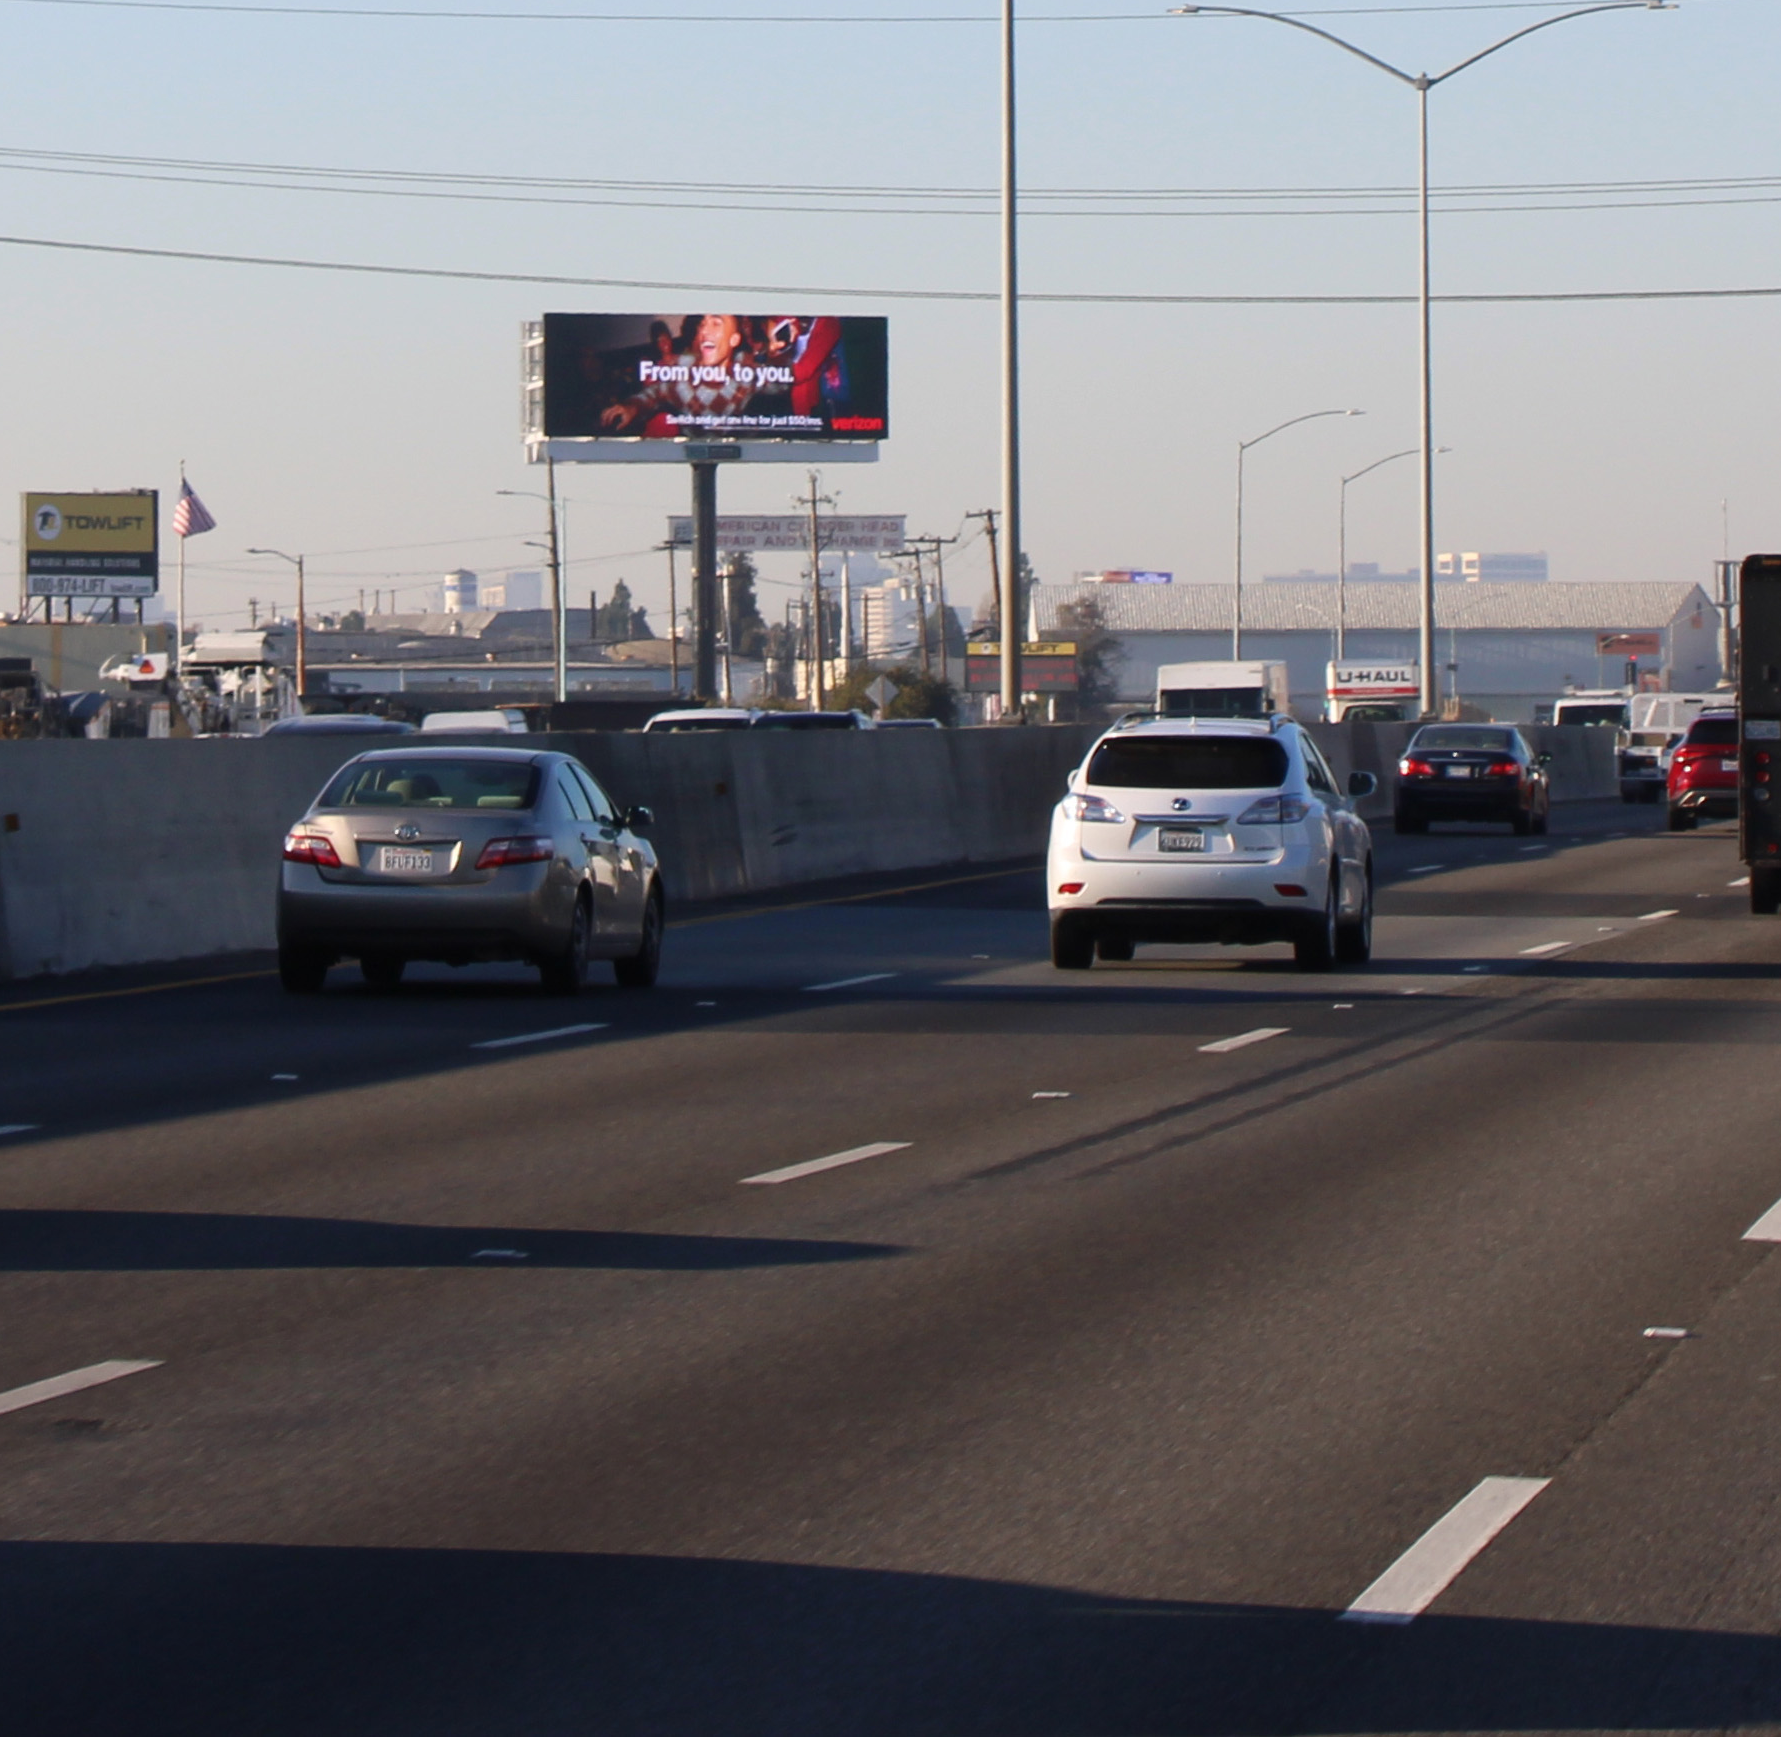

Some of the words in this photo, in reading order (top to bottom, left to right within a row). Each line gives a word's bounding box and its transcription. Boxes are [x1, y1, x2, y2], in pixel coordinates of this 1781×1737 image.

[640, 361, 689, 382] From
[692, 363, 731, 386] you,
[734, 362, 754, 382] to
[756, 364, 794, 387] you.
[831, 415, 882, 430] verizon
[63, 515, 144, 530] TOWLIFT
[717, 520, 780, 532] MERICAN
[788, 520, 854, 532] CYNDER
[861, 520, 899, 532] HEAD
[717, 535, 755, 547] EPAIR
[764, 535, 796, 547] AND
[802, 536, 877, 547] CHANGE
[995, 642, 1058, 653] TWLIFT
[1336, 670, 1412, 683] U-HAUL
